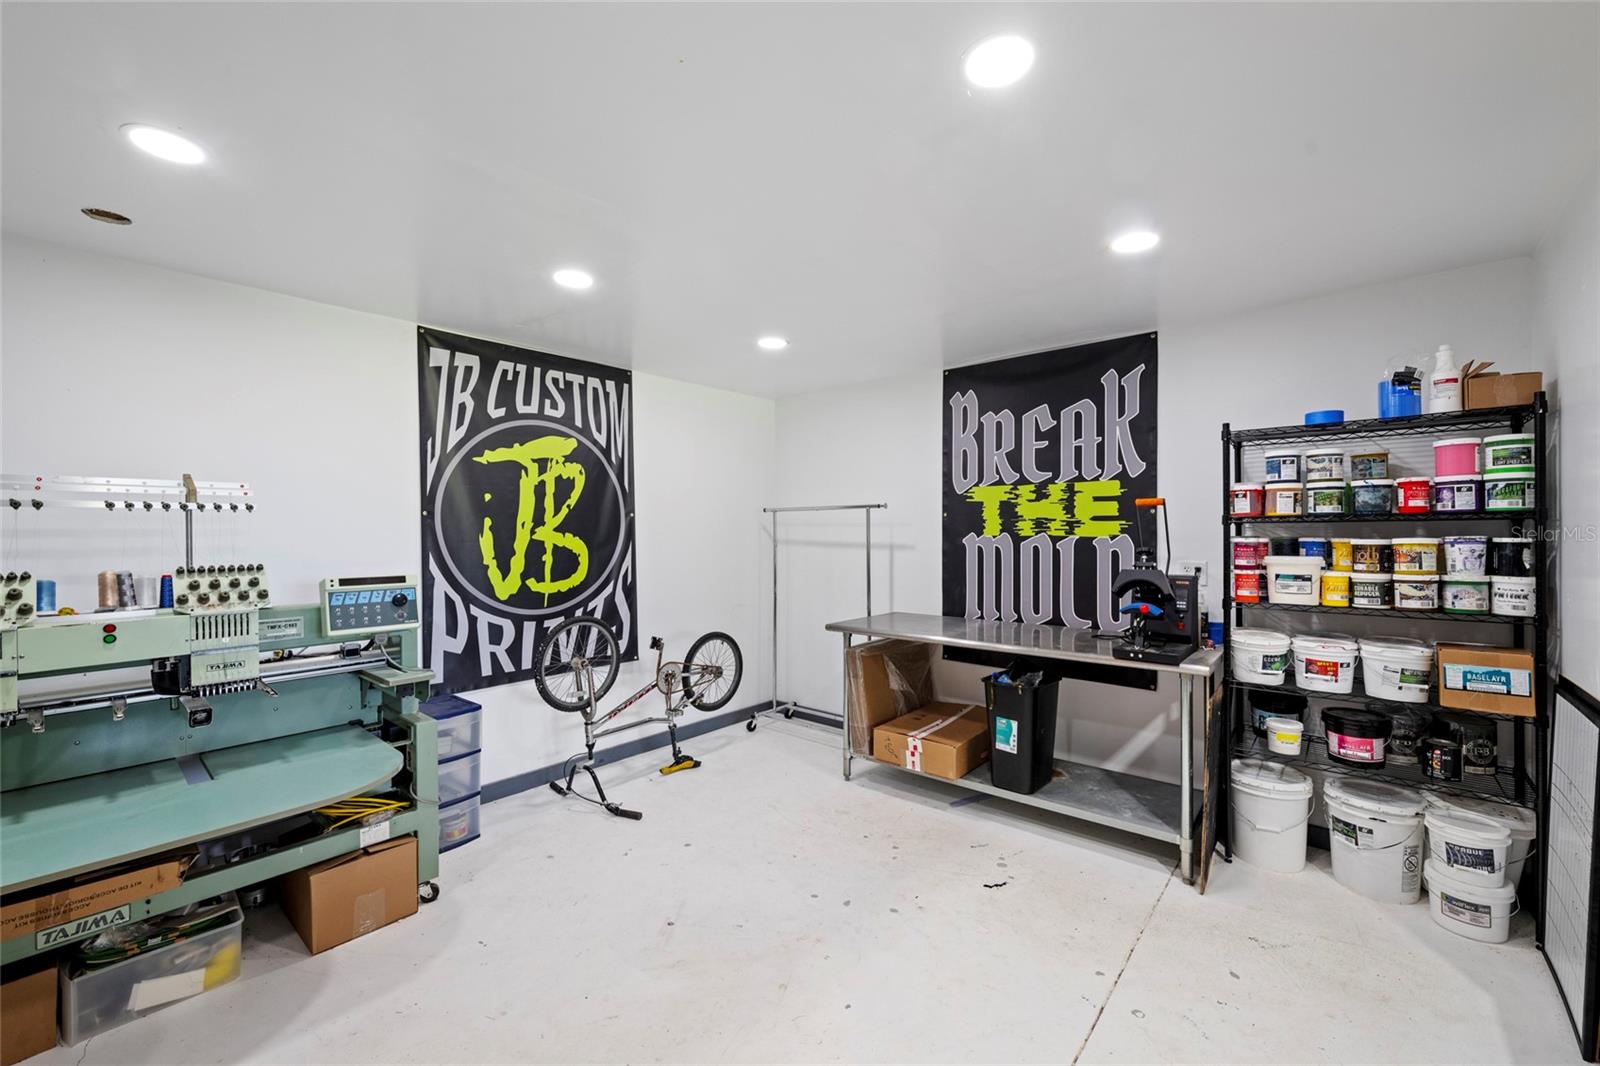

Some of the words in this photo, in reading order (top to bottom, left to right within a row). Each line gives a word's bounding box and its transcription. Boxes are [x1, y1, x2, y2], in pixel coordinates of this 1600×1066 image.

[426, 346, 480, 496] JB
[487, 360, 629, 493] CUSTOM
[950, 363, 1146, 494] BREAK
[965, 480, 1133, 538] THE
[428, 540, 633, 685] PRINTS
[962, 532, 1136, 632] MOLD
[210, 662, 243, 671] TAJIMA
[41, 909, 126, 945] TAJIMA
